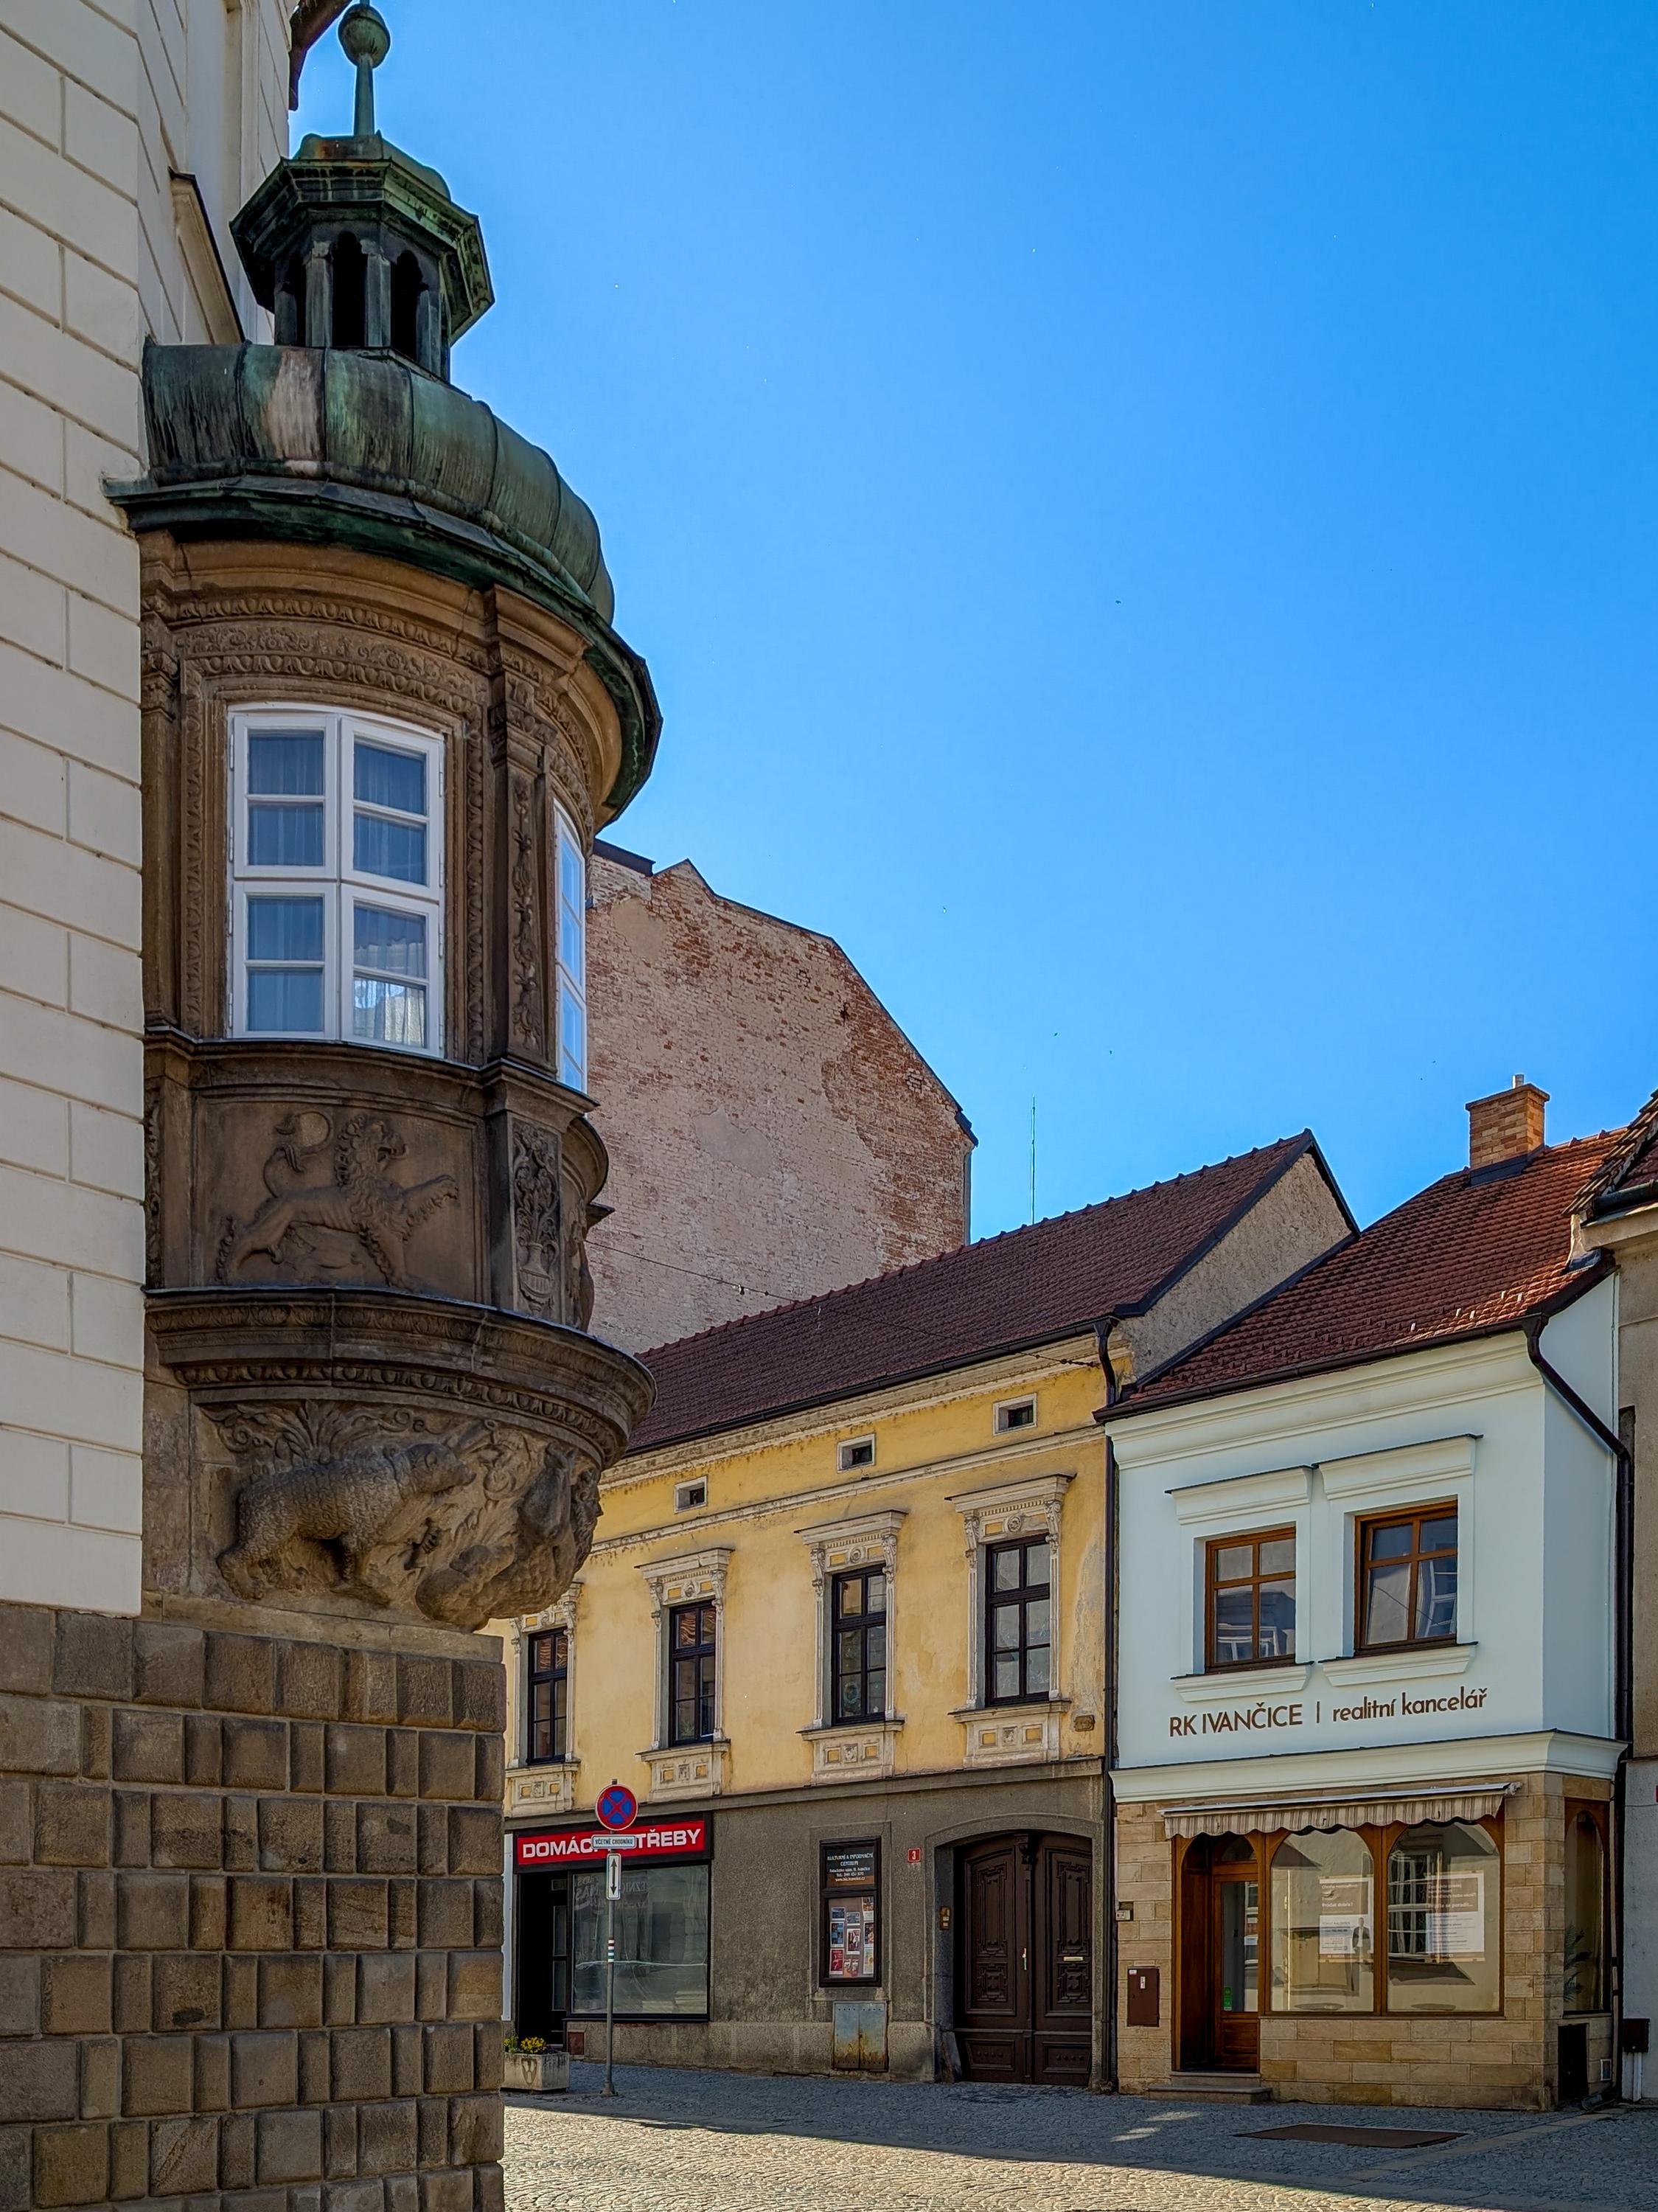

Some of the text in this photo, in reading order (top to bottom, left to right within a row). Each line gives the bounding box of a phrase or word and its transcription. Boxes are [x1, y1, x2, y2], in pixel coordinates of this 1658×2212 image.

[1169, 1686, 1488, 1737] RK IVANČICE realitní kancelář
[523, 1836, 598, 1858] DOMÁC
[912, 1850, 916, 1860] 3
